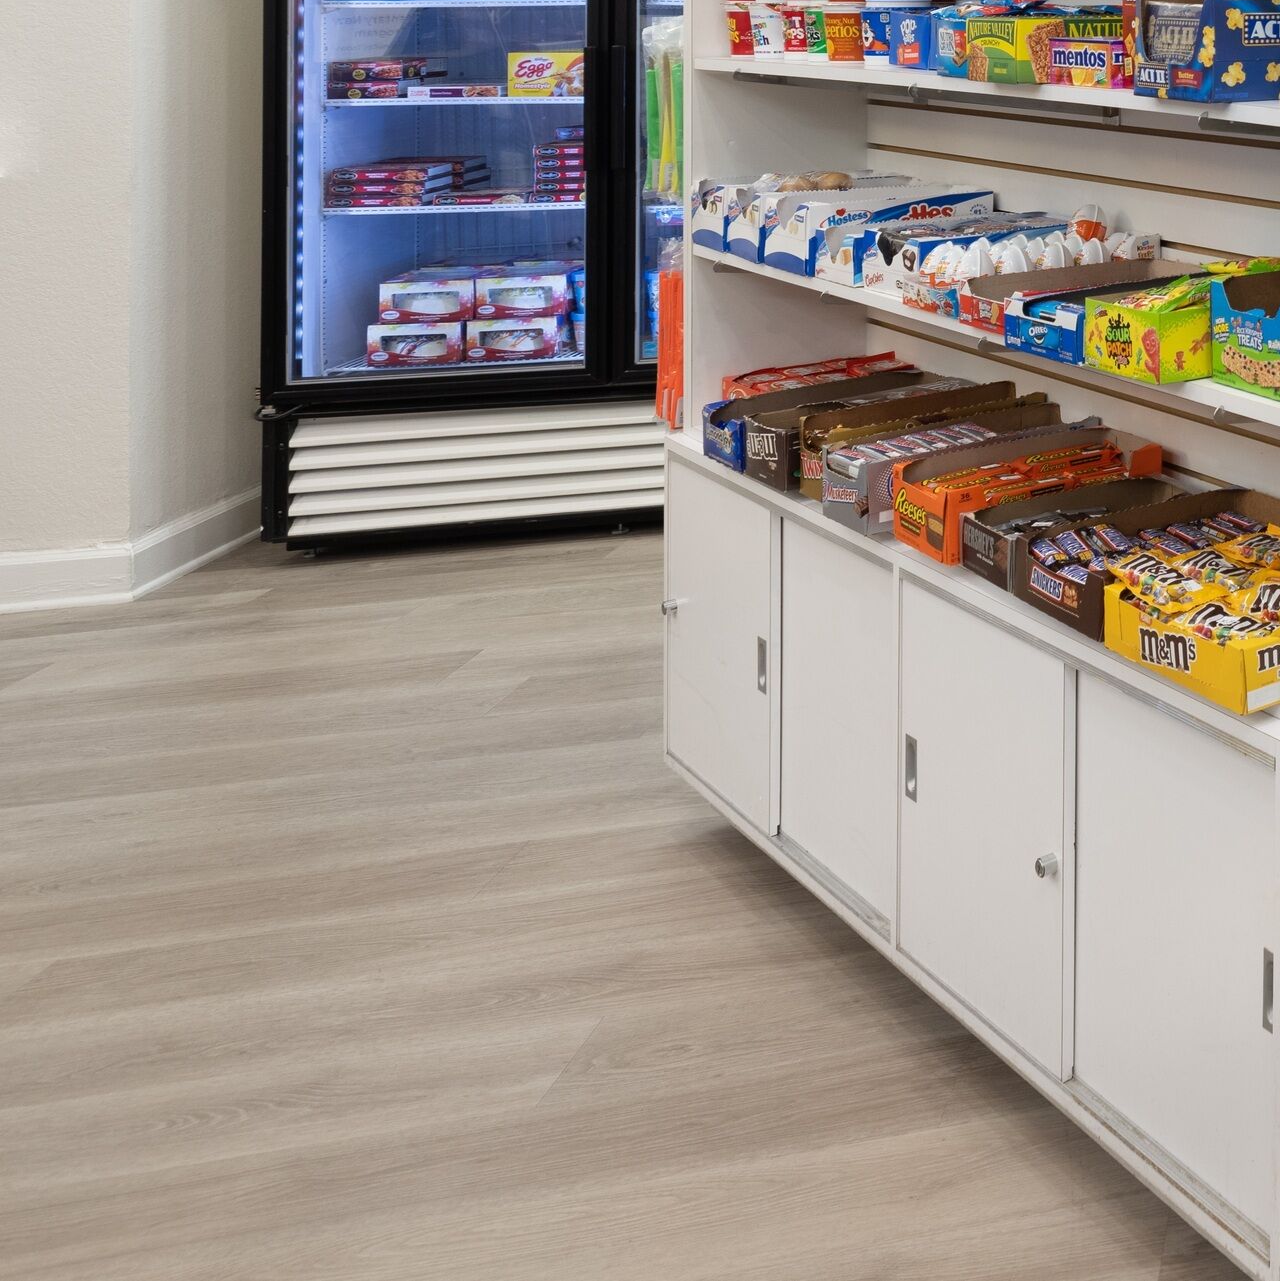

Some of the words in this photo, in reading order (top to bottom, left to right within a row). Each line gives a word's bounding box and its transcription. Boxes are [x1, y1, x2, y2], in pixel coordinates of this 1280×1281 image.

[968, 22, 991, 40] NATURE
[991, 20, 1016, 42] VALLEY
[1053, 47, 1107, 69] mentos
[514, 60, 554, 79] Eggo
[1139, 67, 1155, 85] ACT
[1155, 68, 1167, 85] II
[513, 82, 552, 91] Homestyle
[827, 211, 870, 227] Hostess
[1028, 326, 1048, 337] OREO
[1105, 326, 1131, 342] SOUR
[1106, 340, 1133, 357] PATCH
[1237, 334, 1263, 352] TREATS
[960, 492, 971, 501] 36
[895, 489, 927, 527] Reese's
[963, 526, 996, 557] HERSHEY'S
[1031, 568, 1063, 601] SNICKERS
